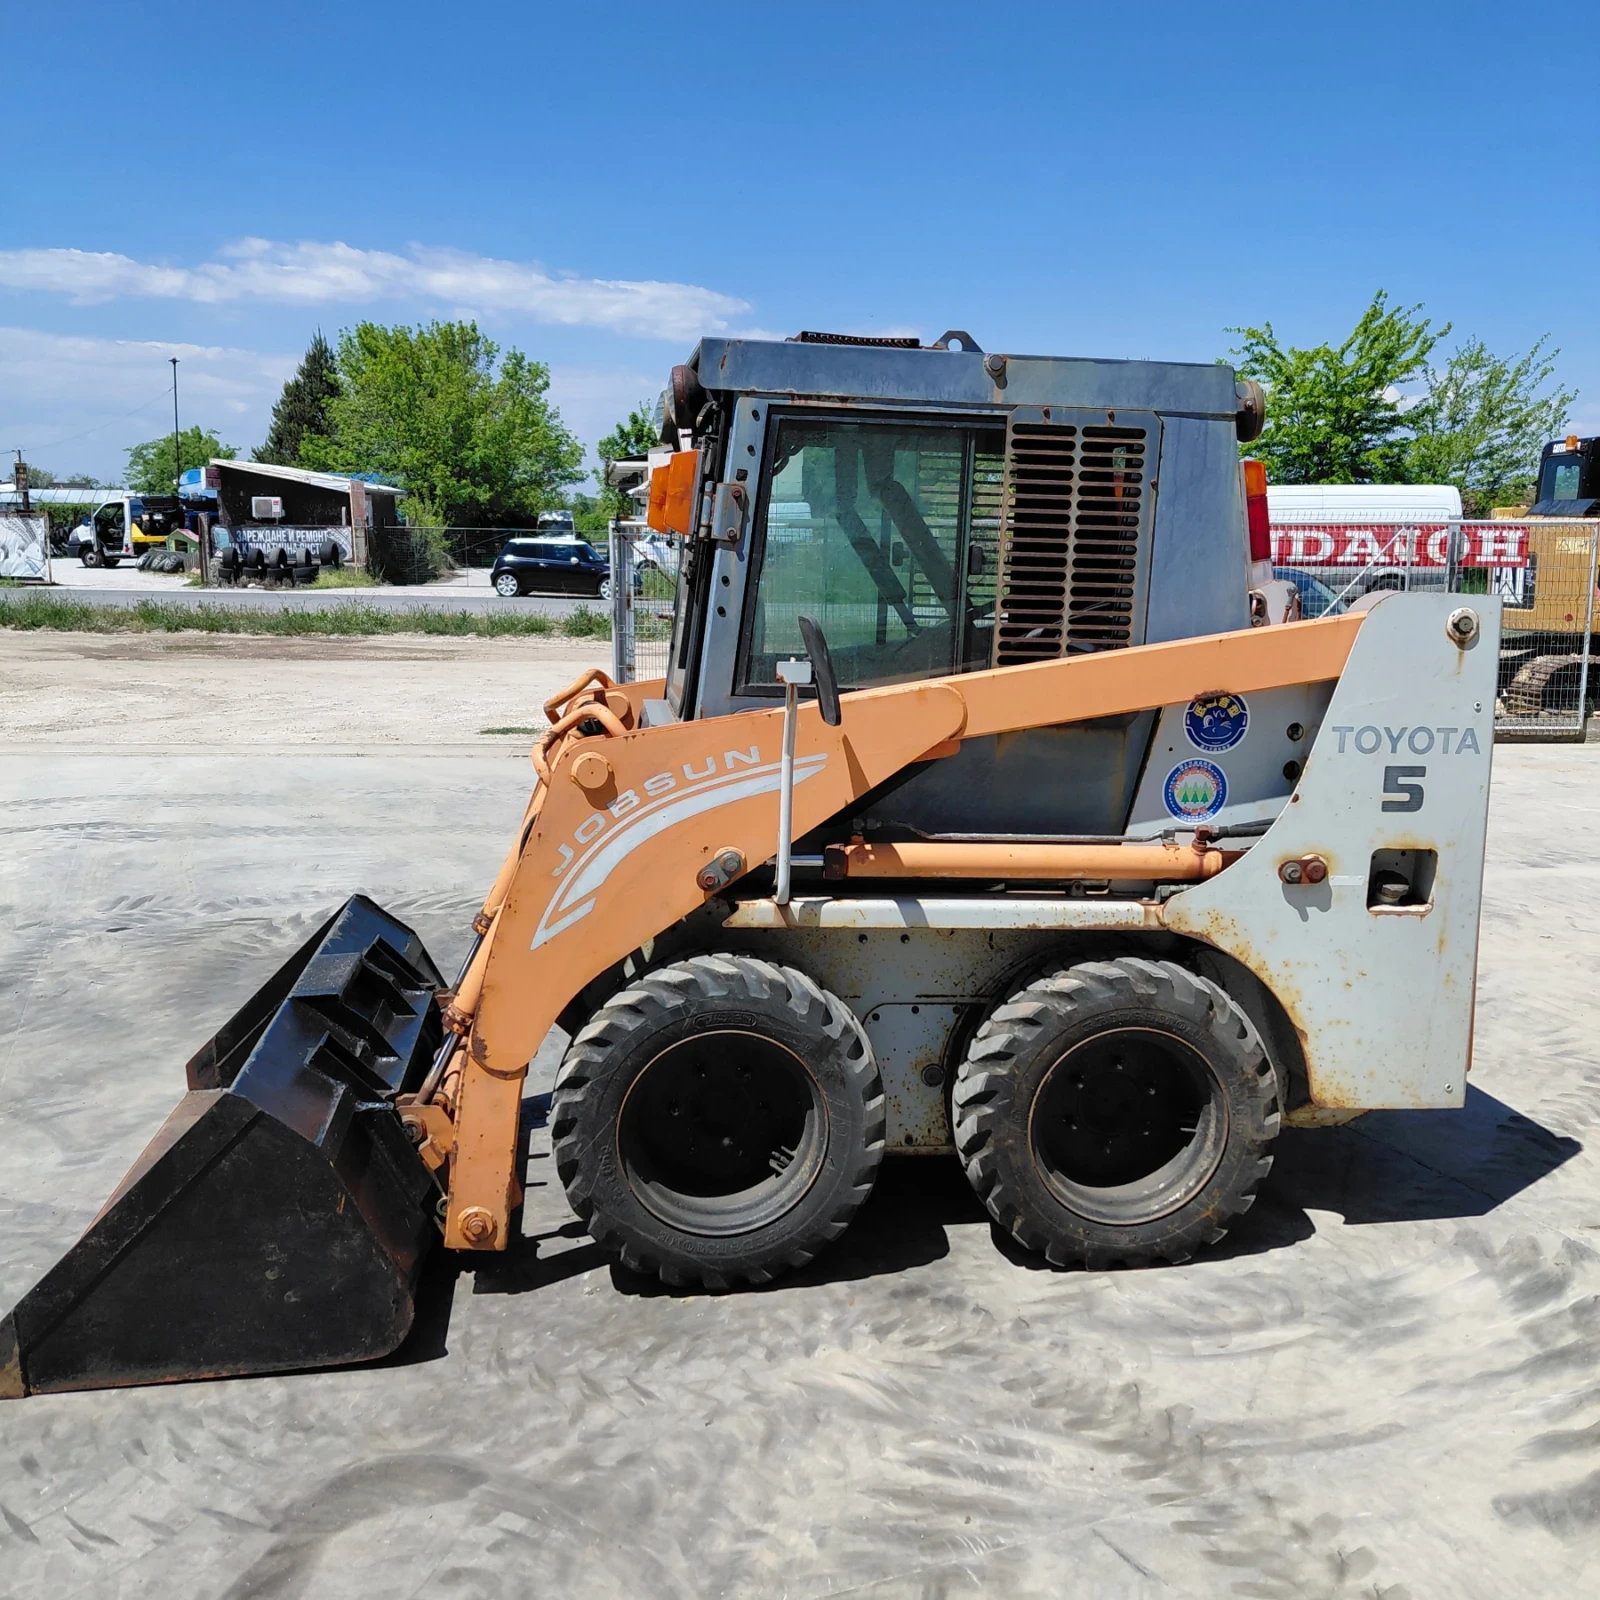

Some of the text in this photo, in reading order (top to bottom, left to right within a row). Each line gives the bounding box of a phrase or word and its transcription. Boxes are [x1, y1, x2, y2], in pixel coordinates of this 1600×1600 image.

[236, 530, 287, 543] ЗАРЕЖДАНЕ
[295, 531, 328, 543] РЕМОНТ
[1332, 726, 1480, 755] TOYOTA
[1381, 765, 1427, 812] 5
[552, 746, 760, 877] JOBSUN
